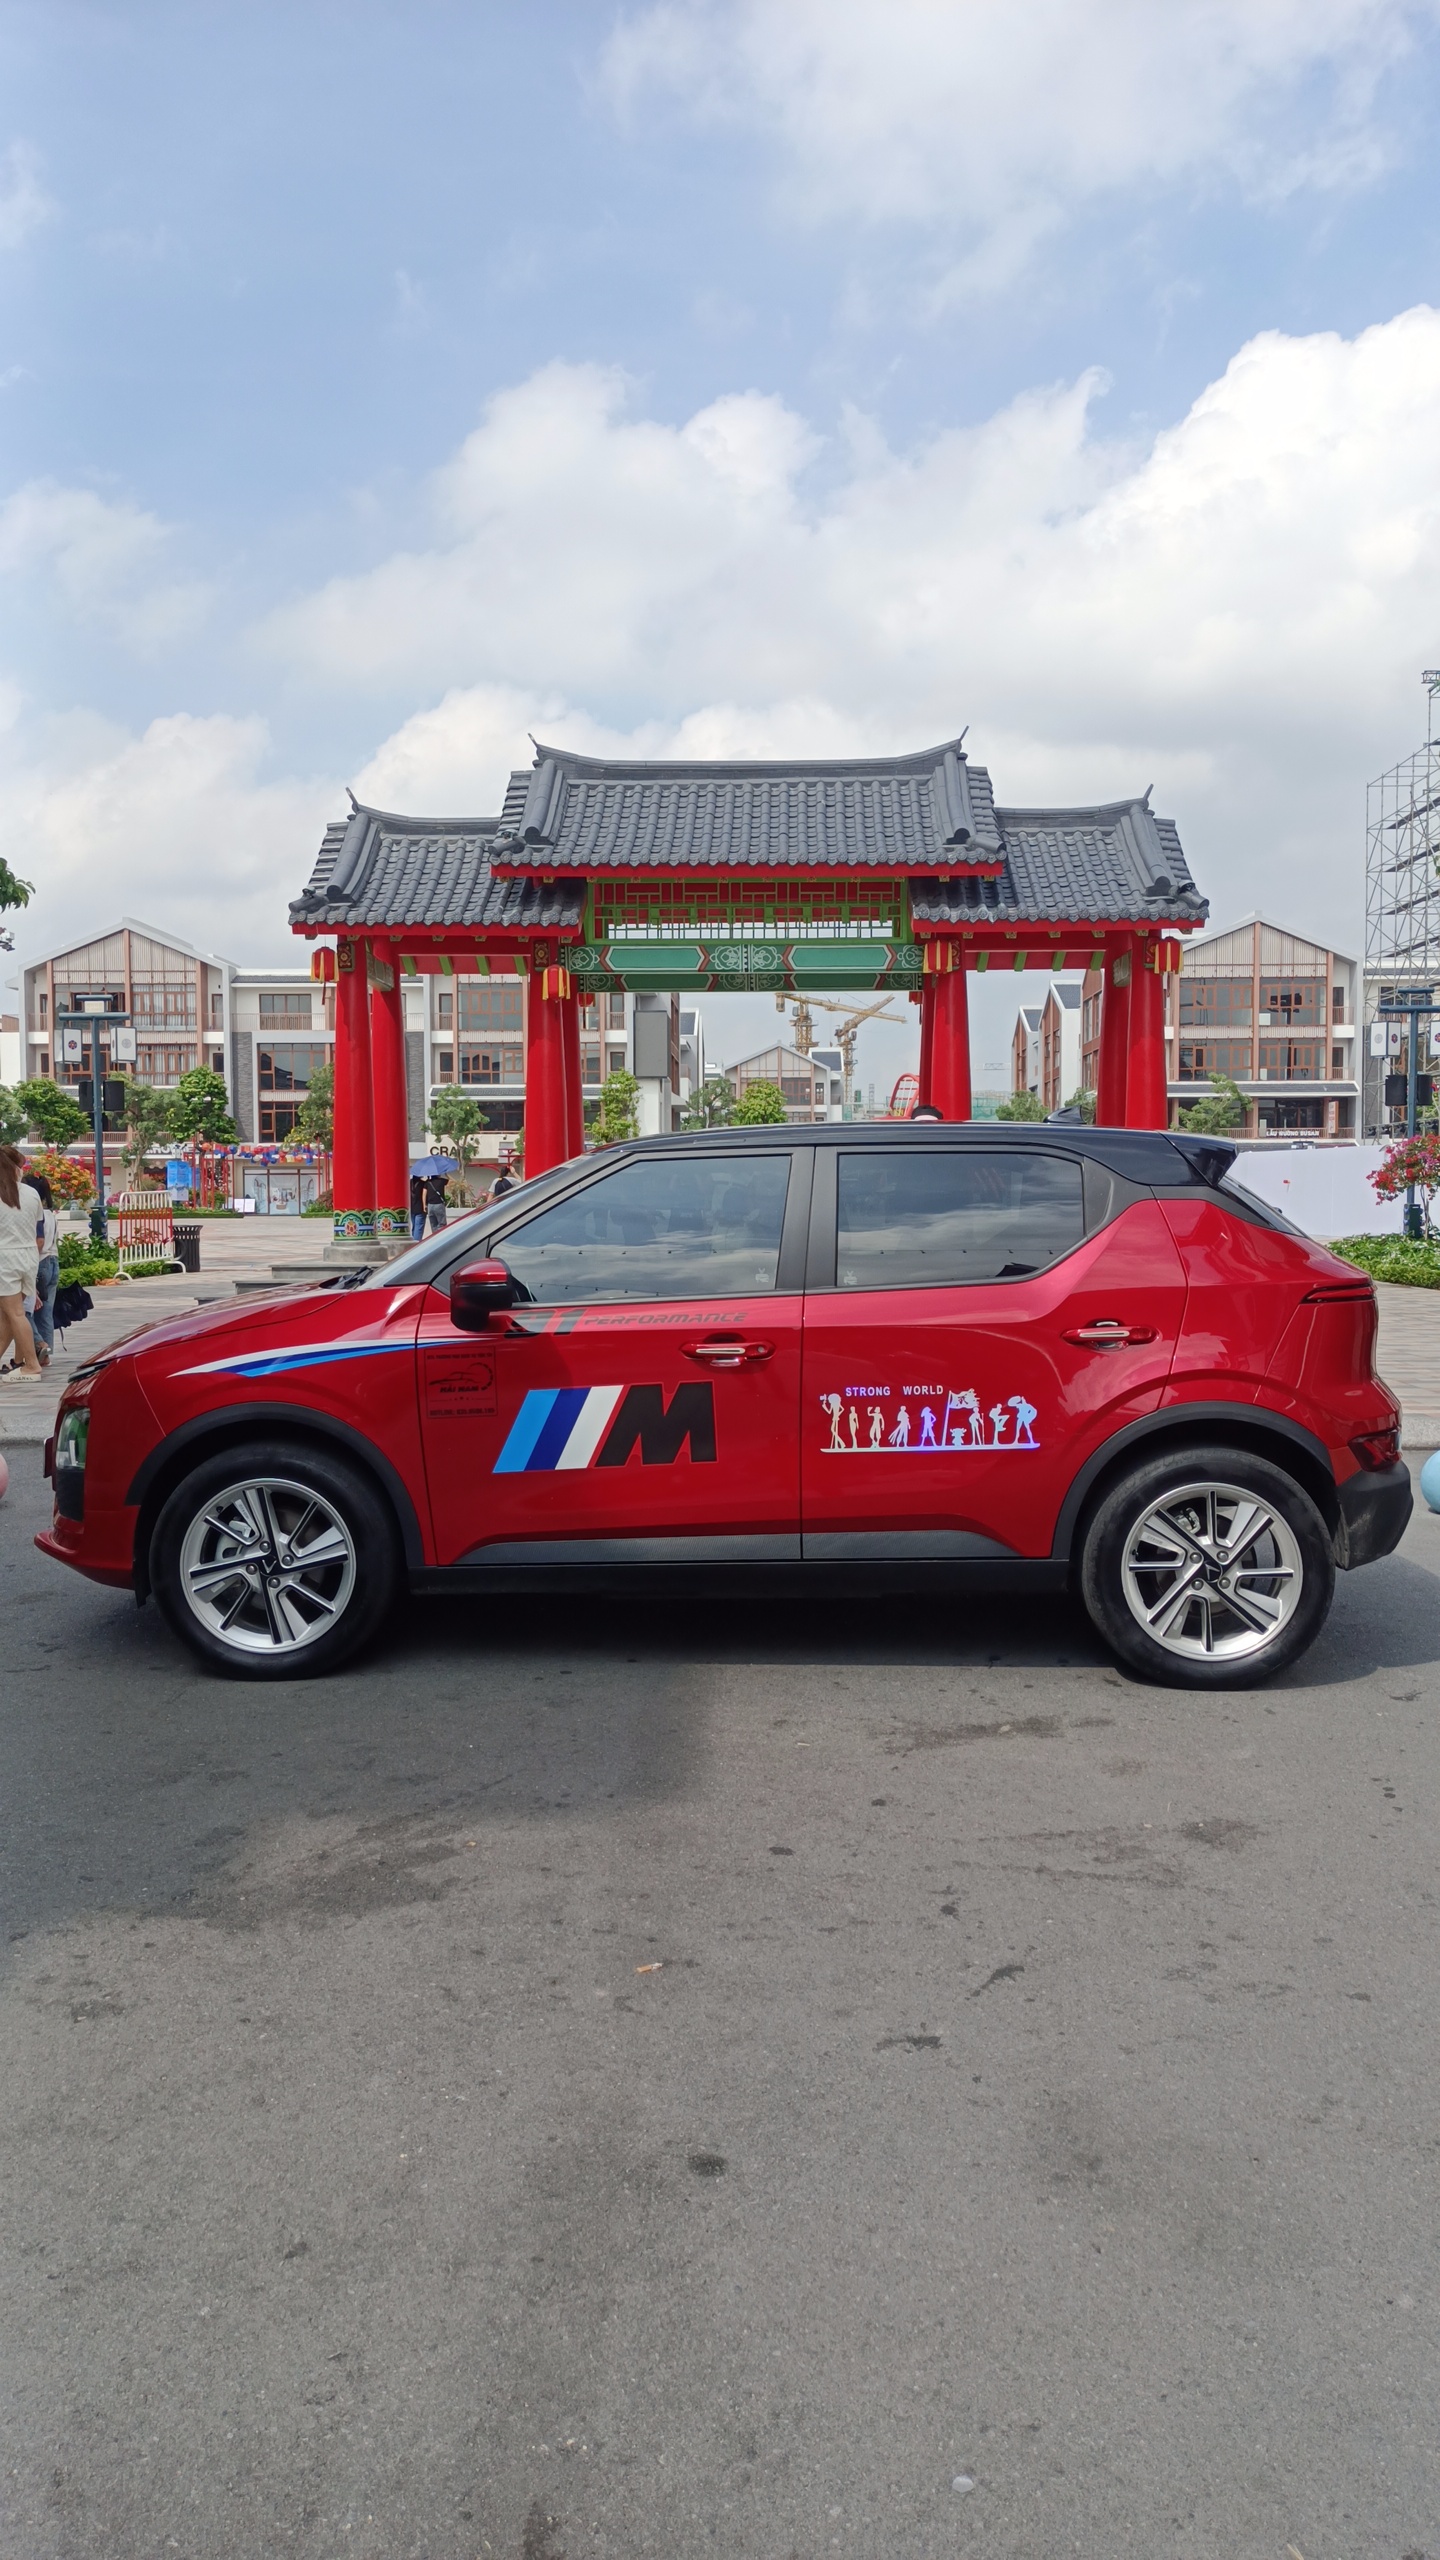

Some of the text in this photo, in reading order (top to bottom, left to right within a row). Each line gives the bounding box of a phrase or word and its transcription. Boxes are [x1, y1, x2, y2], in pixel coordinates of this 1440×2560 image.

[584, 1312, 749, 1326] PERFORMANCE
[845, 1385, 944, 1397] STRONG WORLD
